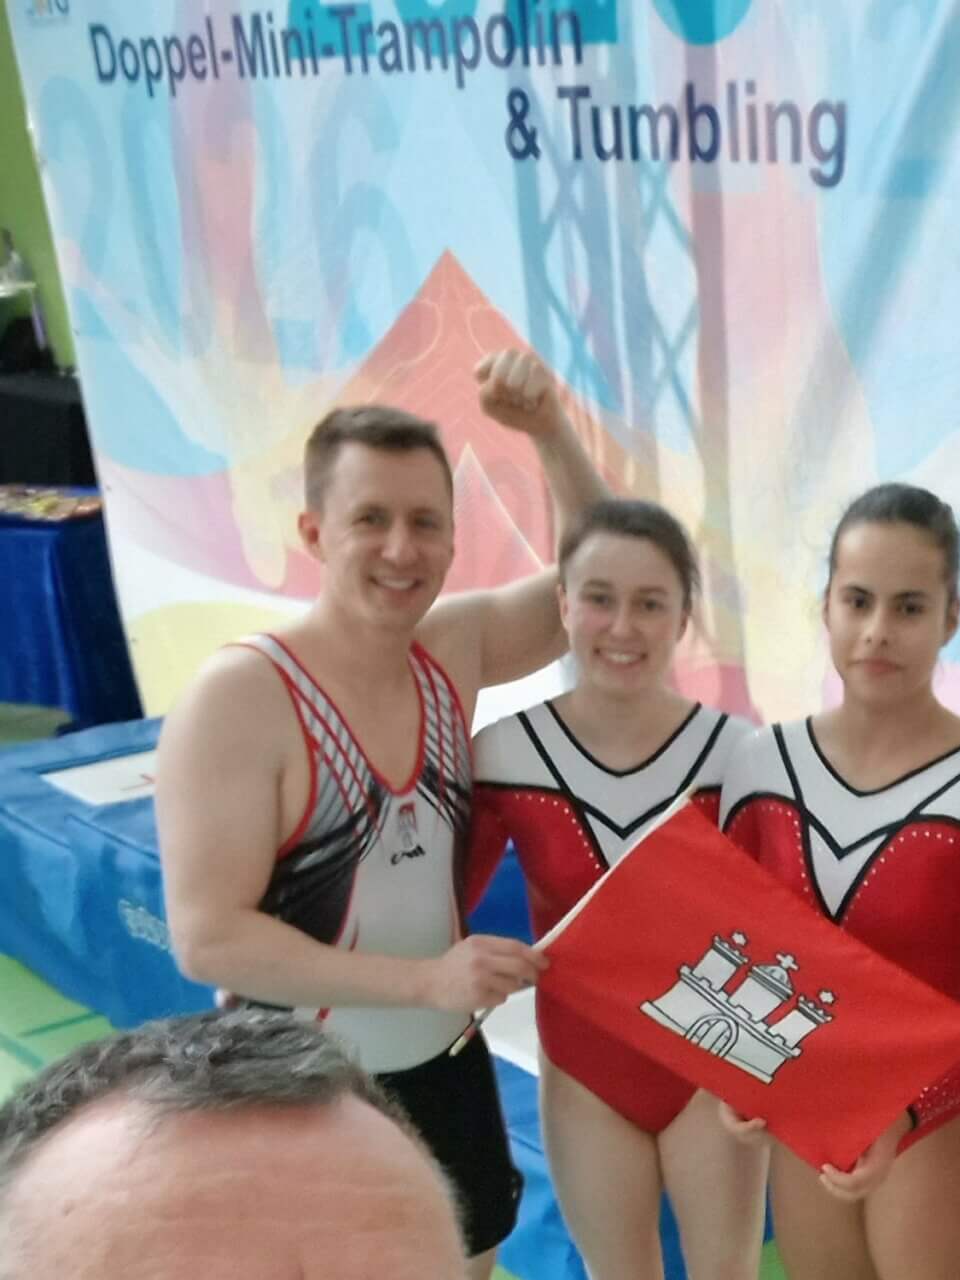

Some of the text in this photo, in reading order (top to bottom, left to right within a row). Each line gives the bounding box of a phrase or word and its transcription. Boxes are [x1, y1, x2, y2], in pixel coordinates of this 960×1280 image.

[87, 0, 584, 97] Doppel-Mini-Trampolin
[505, 79, 848, 189] & Tumbling
